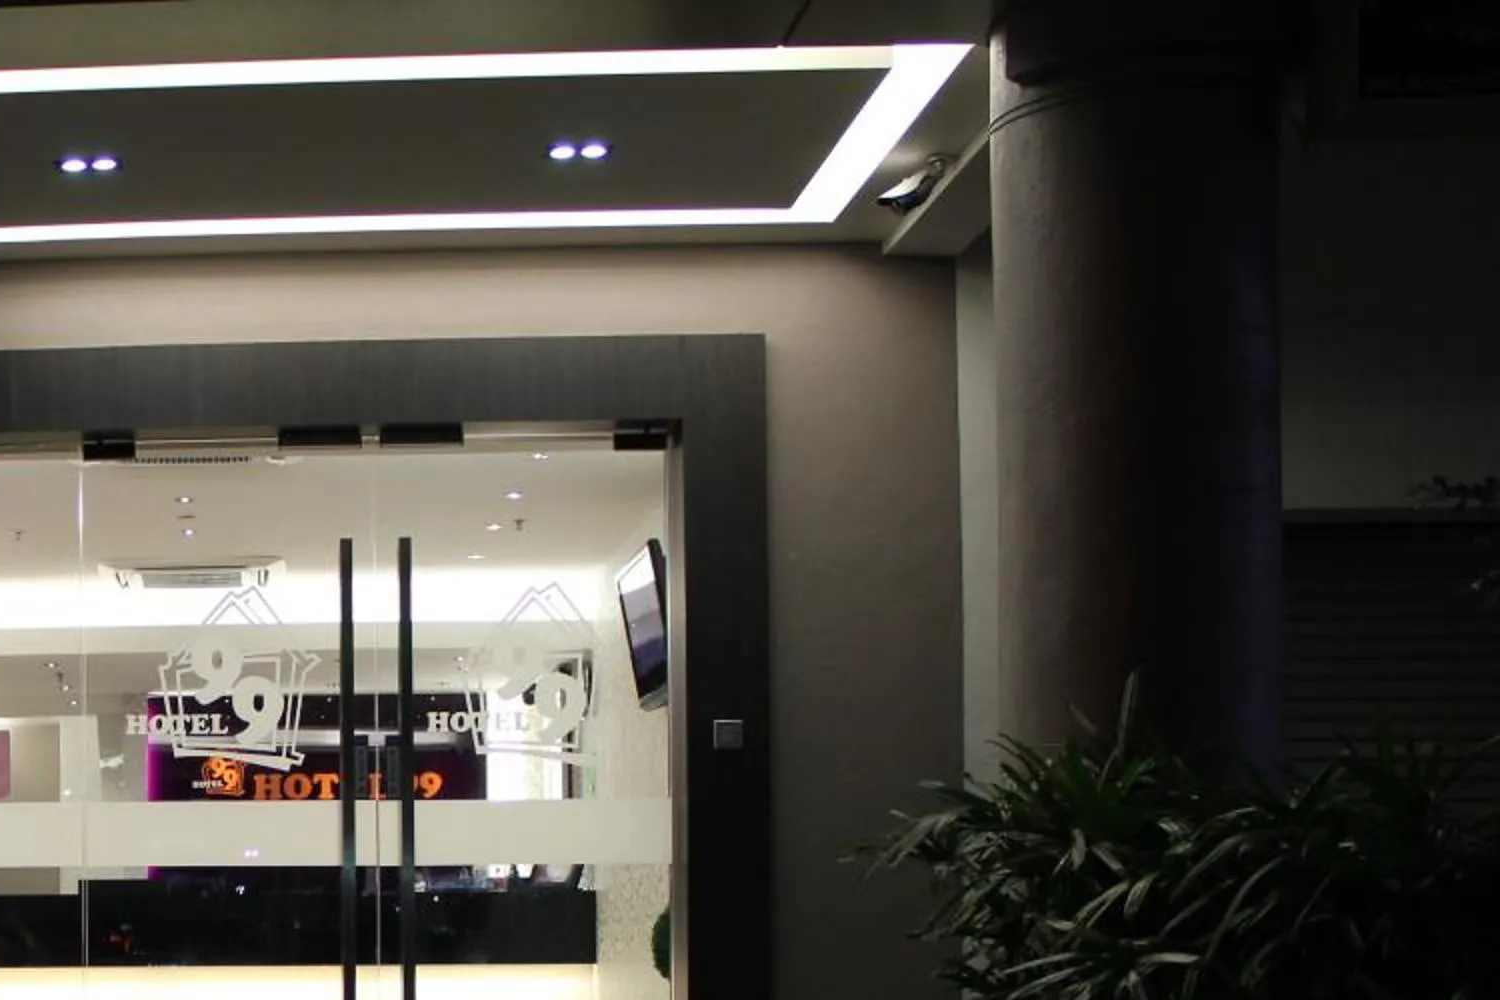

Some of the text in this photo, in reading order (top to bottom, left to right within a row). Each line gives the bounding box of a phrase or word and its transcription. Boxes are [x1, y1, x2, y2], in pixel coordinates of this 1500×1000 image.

[191, 633, 285, 746] 99
[125, 713, 229, 736] HOTEL
[426, 711, 530, 733] HOTEL
[253, 771, 443, 801] HOTL 9
